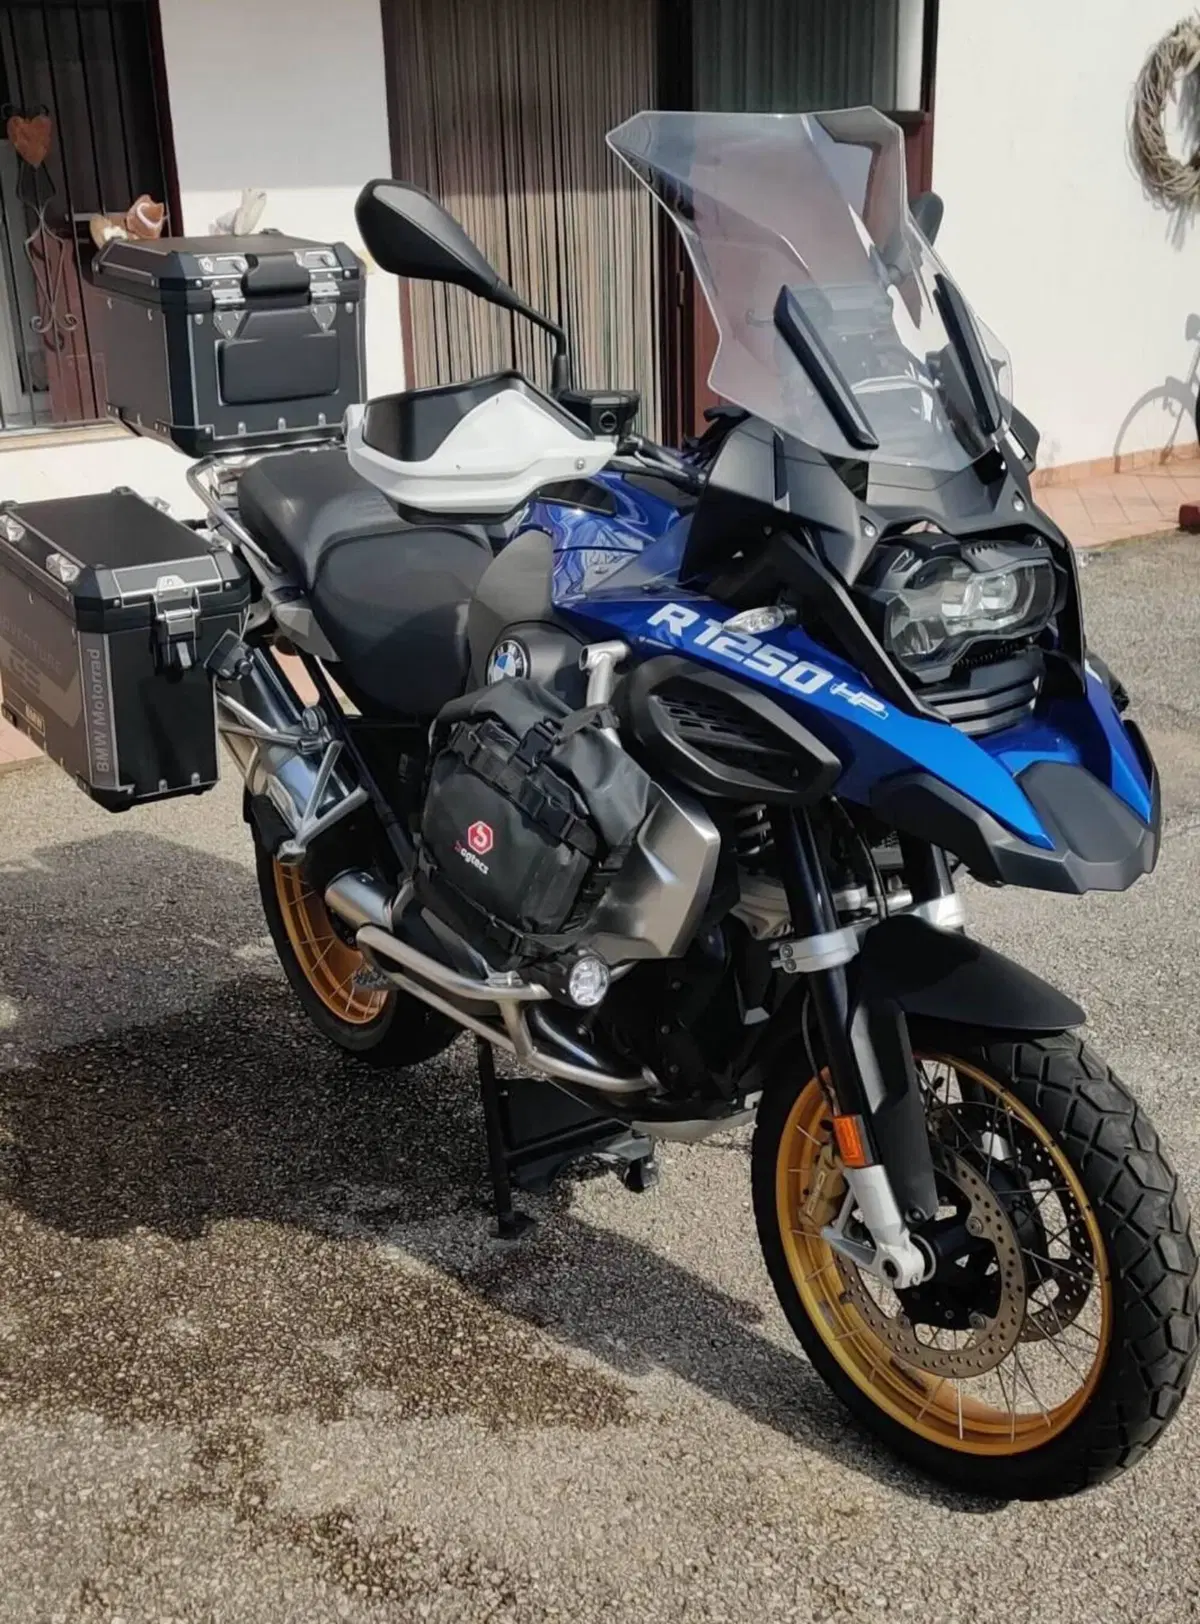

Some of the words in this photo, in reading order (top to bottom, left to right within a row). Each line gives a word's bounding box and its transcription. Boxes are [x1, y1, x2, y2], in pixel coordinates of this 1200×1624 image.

[87, 648, 108, 727] Motorrad
[647, 602, 700, 637] R
[693, 618, 834, 694] 1250
[829, 682, 889, 721] HP
[96, 731, 110, 773] BMW
